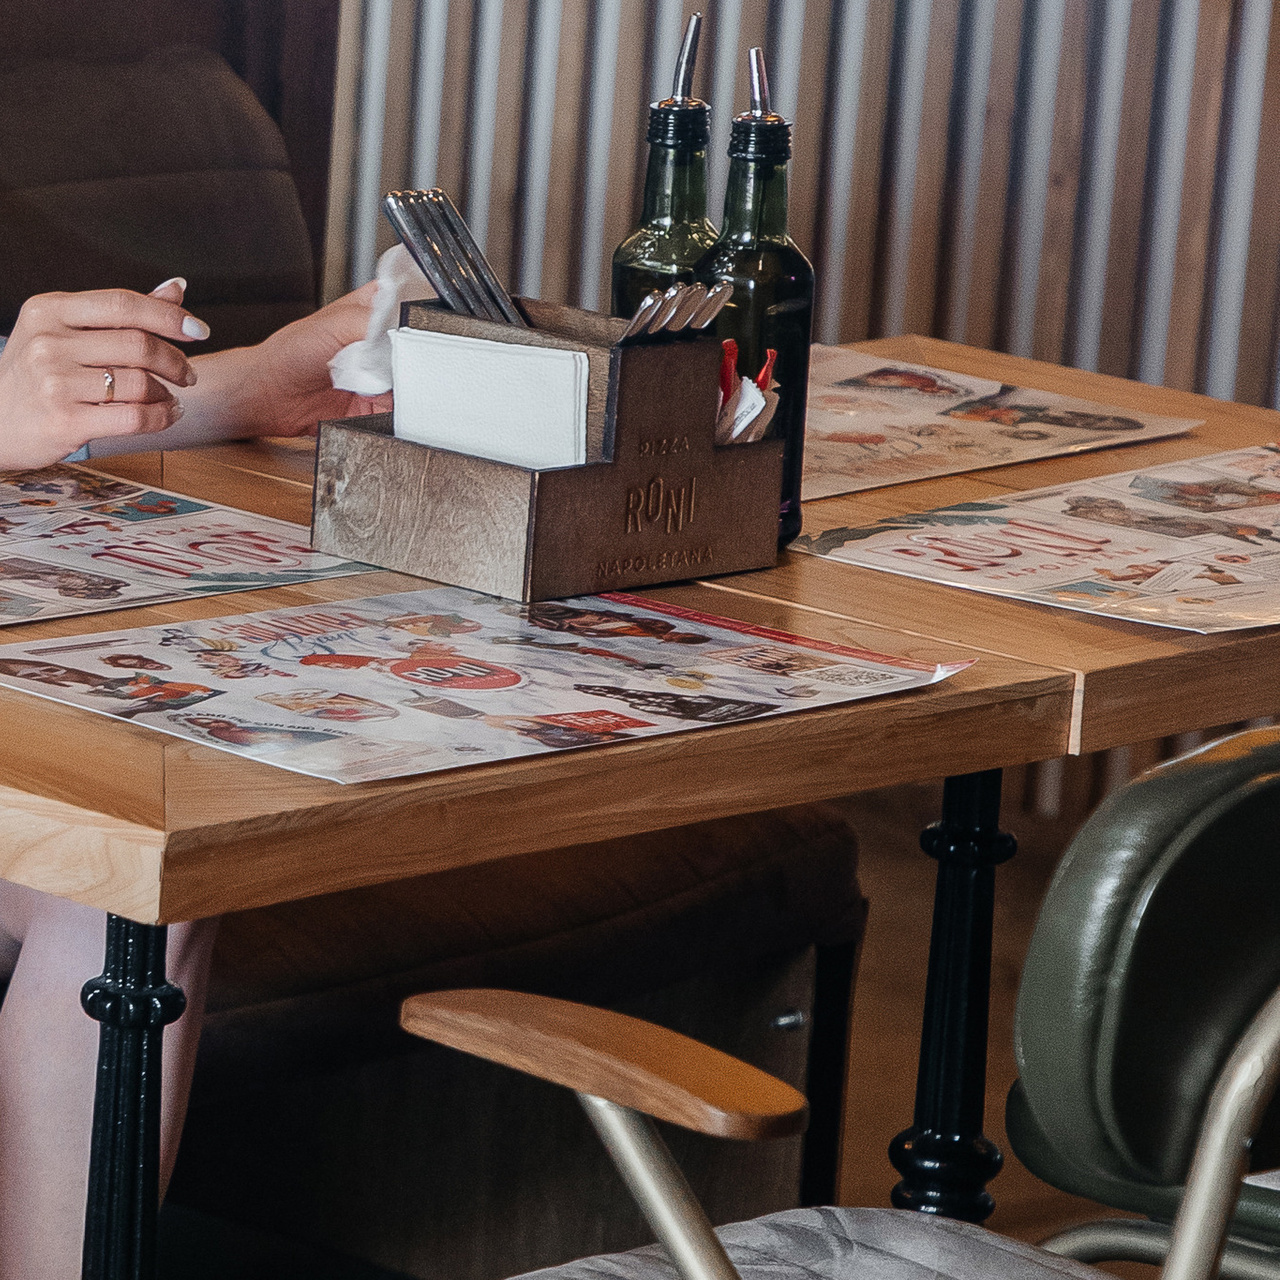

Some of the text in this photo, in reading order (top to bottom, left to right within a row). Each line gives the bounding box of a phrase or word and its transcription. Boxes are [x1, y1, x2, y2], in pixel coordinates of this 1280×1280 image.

[639, 436, 690, 457] PIZZA
[625, 476, 696, 534] RONI
[400, 662, 493, 682] RONI
